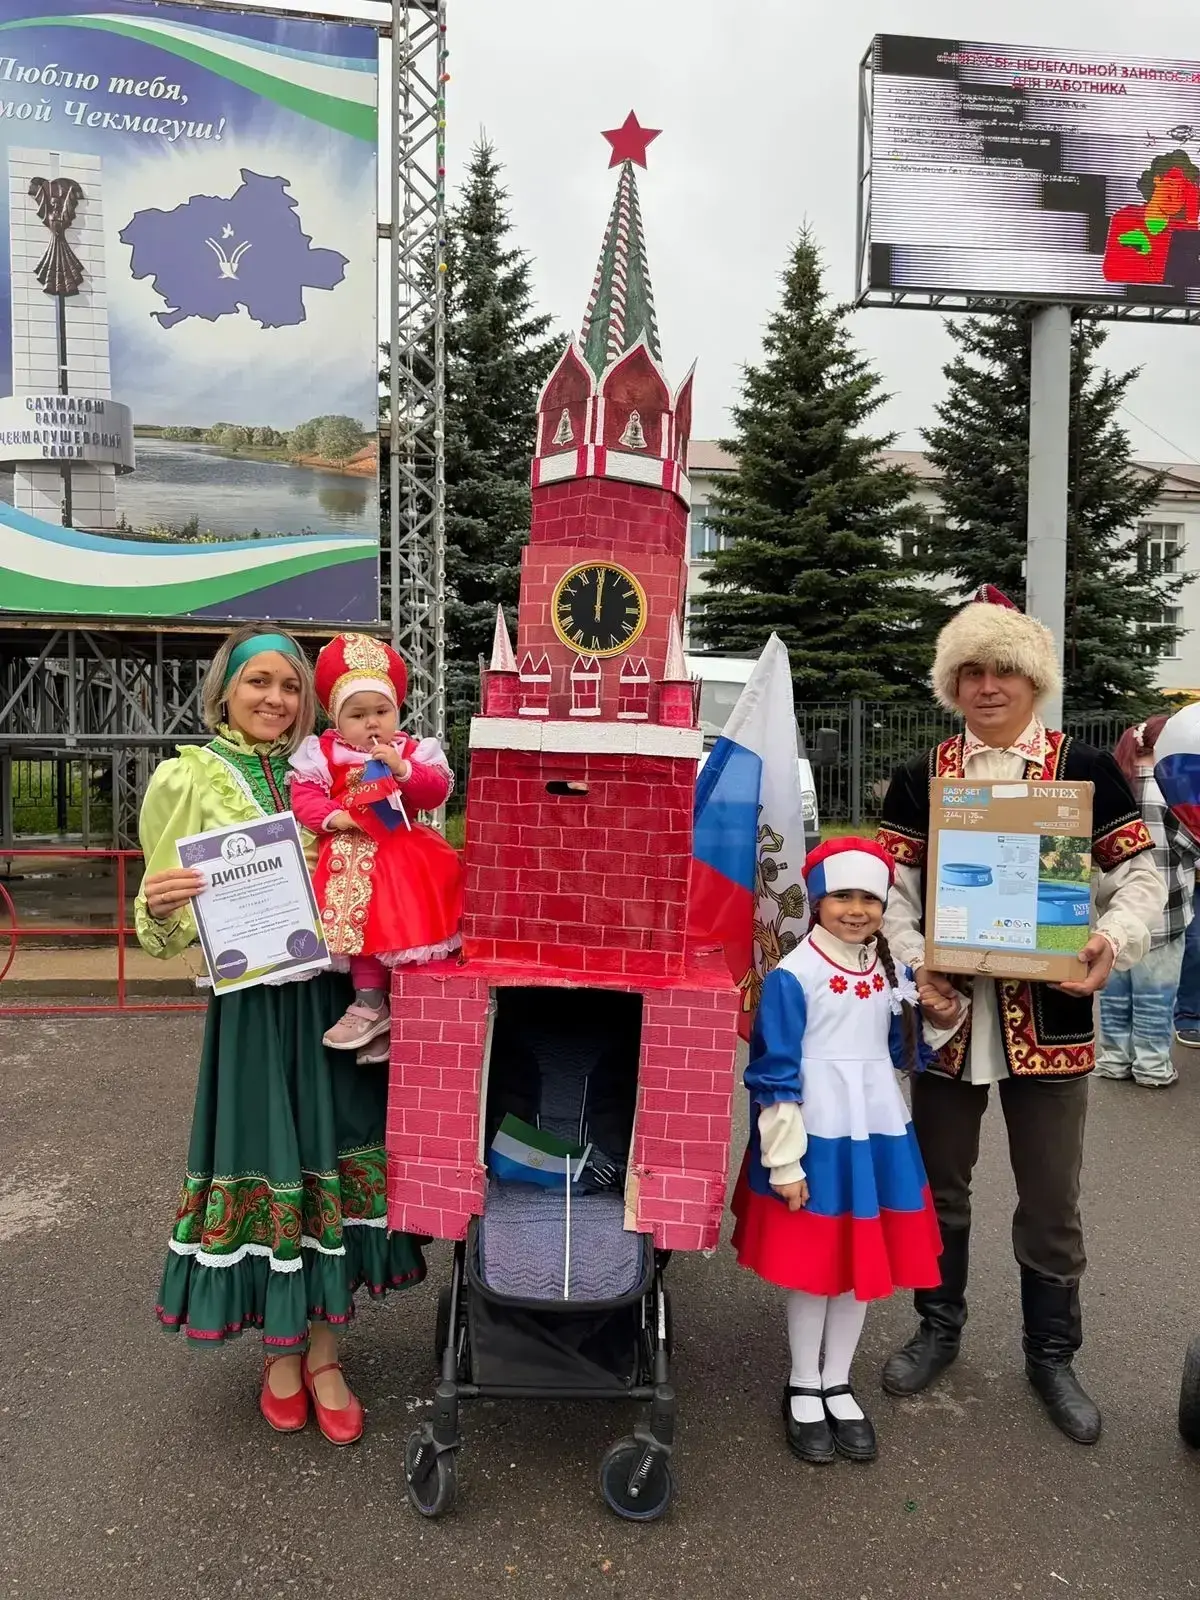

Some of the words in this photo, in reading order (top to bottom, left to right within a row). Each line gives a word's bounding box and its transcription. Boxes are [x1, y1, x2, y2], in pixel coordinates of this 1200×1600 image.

[1017, 59, 1117, 77] НЕЛЕГАЛЬНОЙ
[108, 76, 189, 105] тебя,
[1045, 77, 1127, 95] РАБОТНИКА
[64, 101, 226, 142] Чекмагуш!
[1032, 787, 1080, 799] INTEX
[211, 856, 283, 887] ДИПЛОМ
